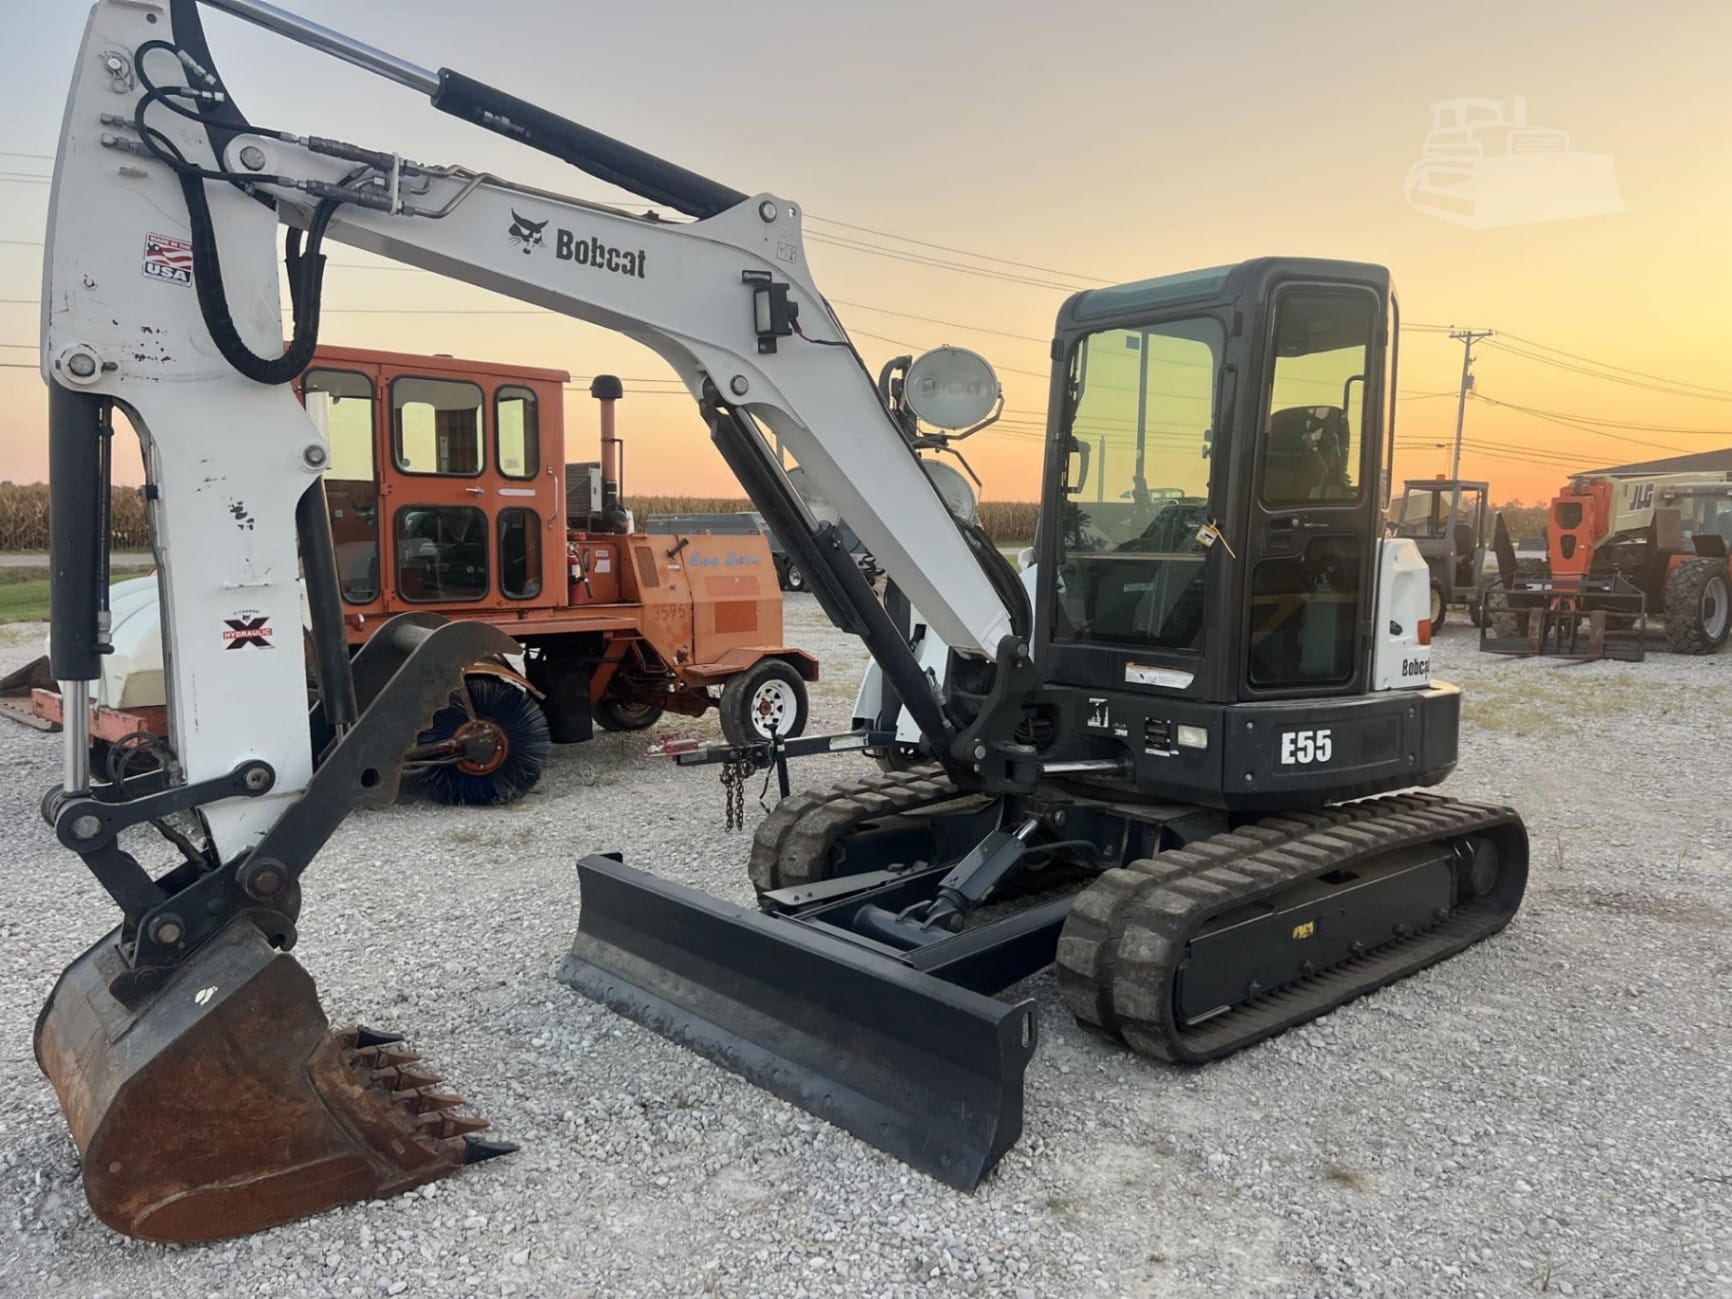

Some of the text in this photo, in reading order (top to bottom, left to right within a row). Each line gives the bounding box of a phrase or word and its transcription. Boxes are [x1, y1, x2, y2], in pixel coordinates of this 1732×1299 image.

[556, 228, 646, 279] Bobcat
[147, 263, 188, 282] USA
[1629, 484, 1654, 511] JLG
[1281, 729, 1332, 765] E55
